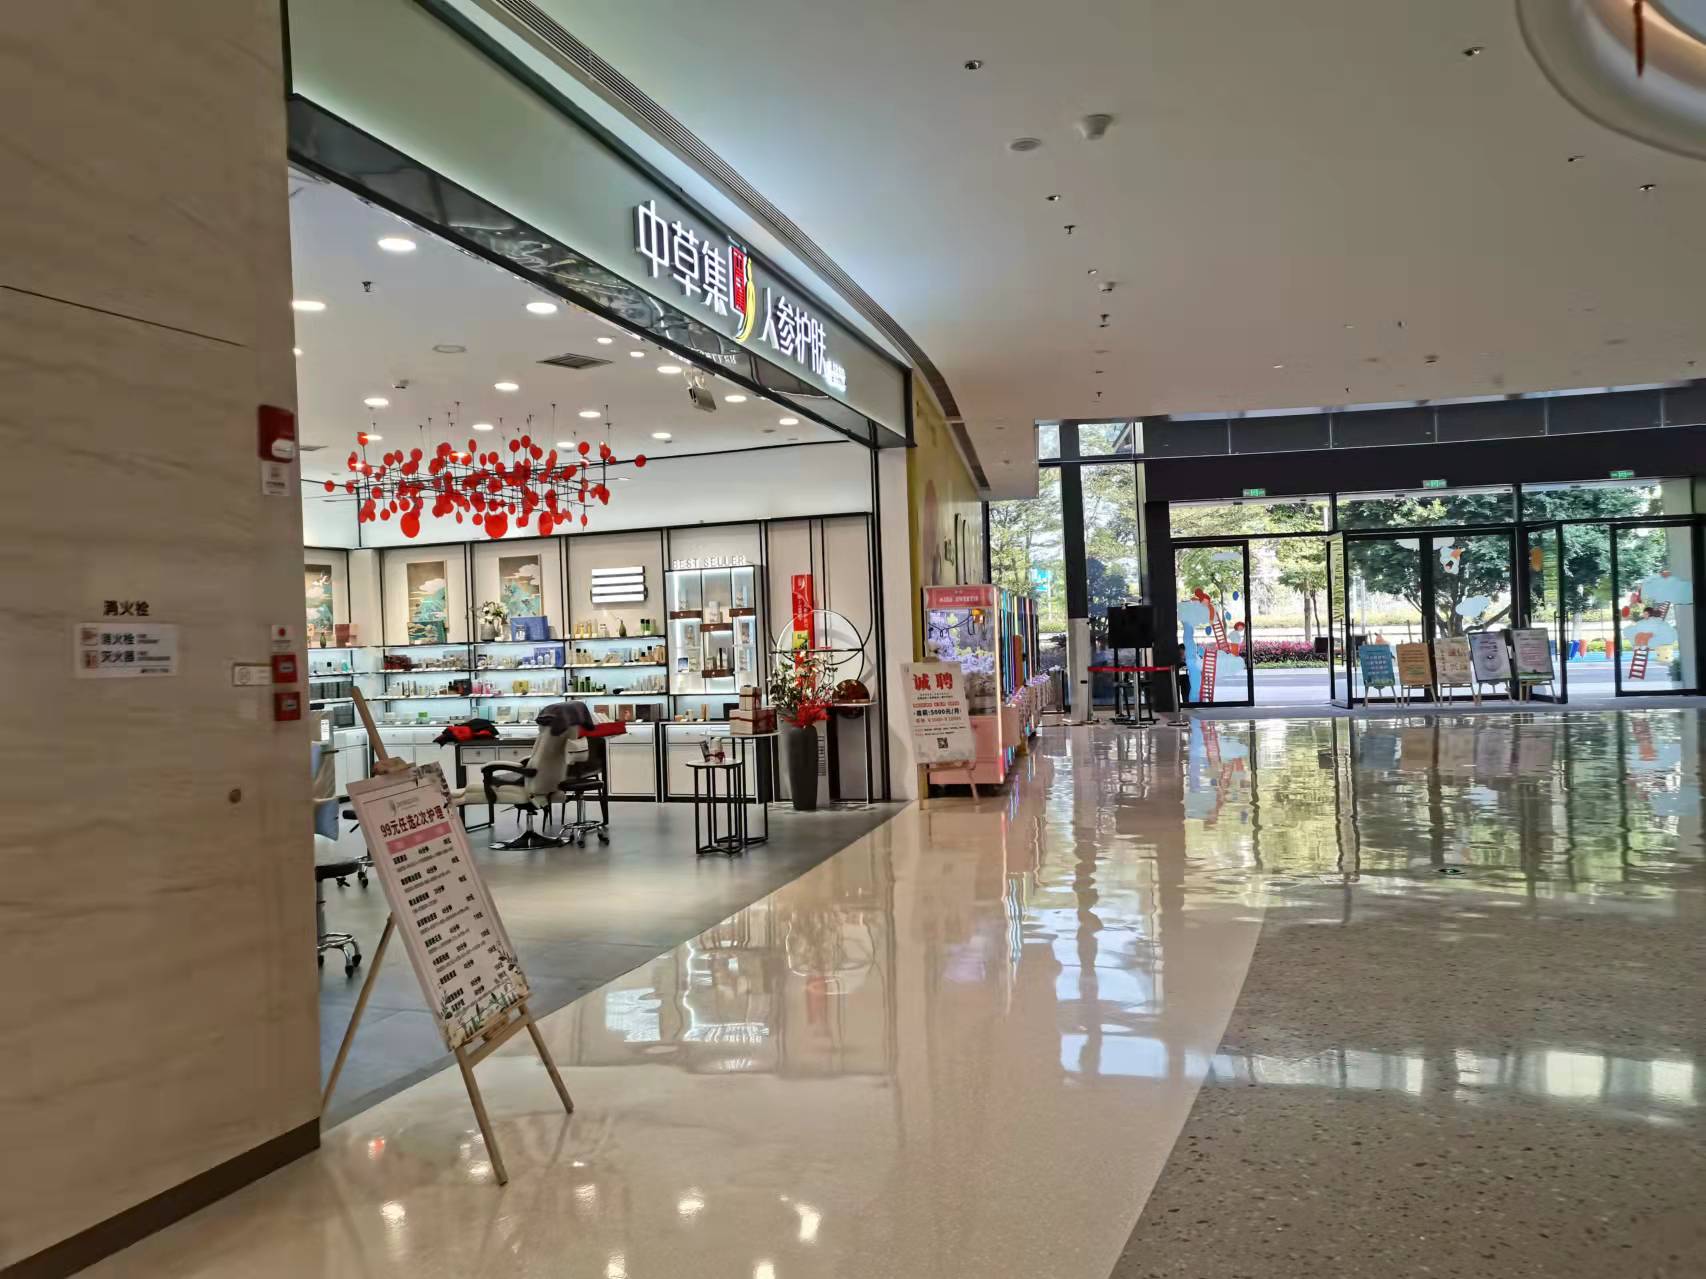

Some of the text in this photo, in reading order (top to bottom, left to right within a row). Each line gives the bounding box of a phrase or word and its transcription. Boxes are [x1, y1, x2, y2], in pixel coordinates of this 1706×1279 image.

[638, 200, 729, 316] 中草集
[757, 288, 828, 374] 人参护肤
[671, 555, 746, 568] BEST SELLER
[103, 600, 150, 616] 消火栓
[912, 672, 953, 691] 诚聘
[380, 806, 445, 838] 99元任选2次护理
